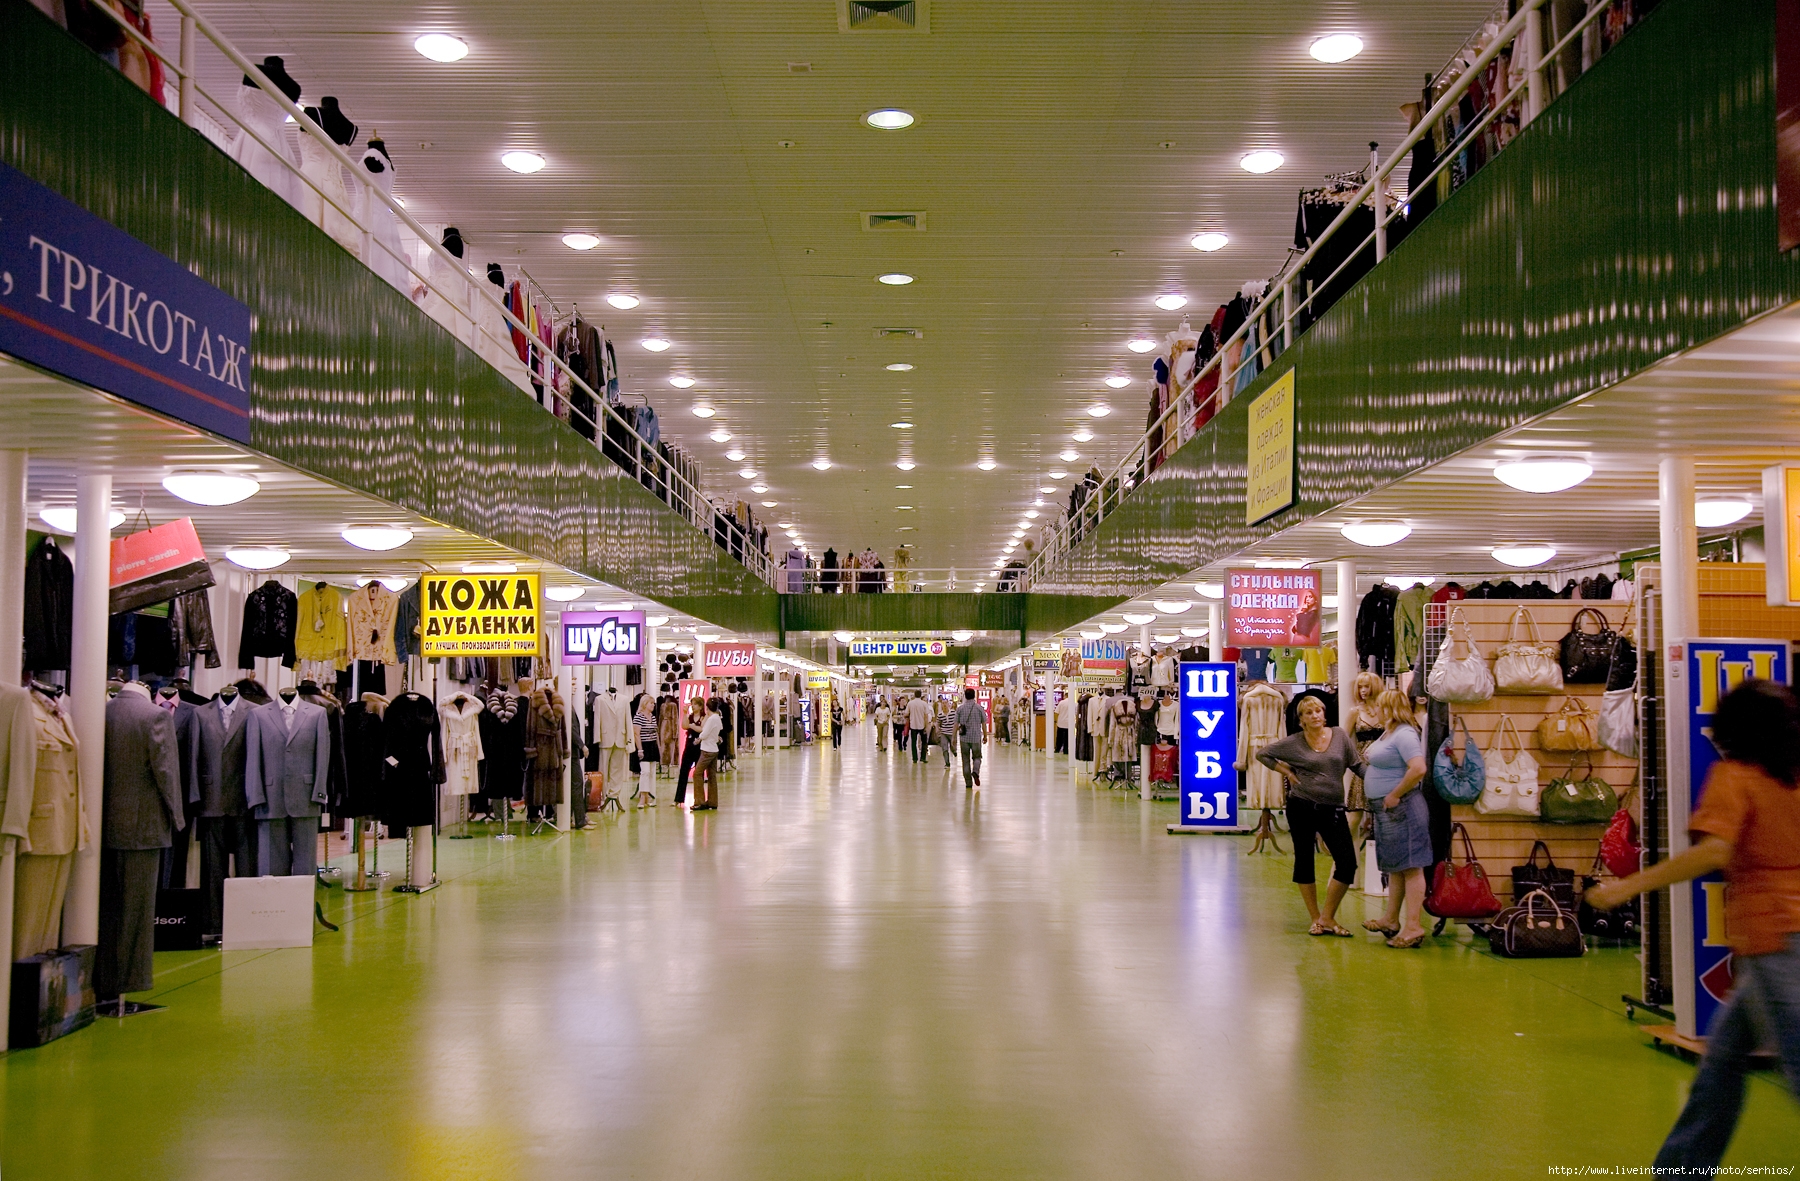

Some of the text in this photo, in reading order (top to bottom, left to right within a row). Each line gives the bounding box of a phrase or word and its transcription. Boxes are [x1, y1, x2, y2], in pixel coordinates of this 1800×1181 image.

[29, 234, 247, 392] ТРИКОТАЖ
[1256, 387, 1286, 422] женская
[1256, 417, 1284, 452] одежда
[1252, 445, 1288, 481] из Италии
[1256, 476, 1287, 508] Франции
[116, 548, 180, 574] pierre cardin
[428, 579, 534, 611] КОЖА
[1231, 575, 1314, 589] СТИЛЬНАЯ
[1231, 593, 1298, 609] ОДЕЖДА
[426, 616, 535, 636] ДУБЛЕНКИ
[568, 620, 637, 659] шубы
[425, 639, 535, 651] ОТ ЛУЧШИХ ПРОИЗВОДИТЕЛЕЙ ТУРЦИИ
[706, 650, 754, 667] ШУБЫ
[853, 643, 894, 655] ЦЕНТР
[897, 643, 927, 653] ШУБ
[1082, 639, 1125, 659] ШУБЫ
[1187, 670, 1230, 819] ШУБЫ
